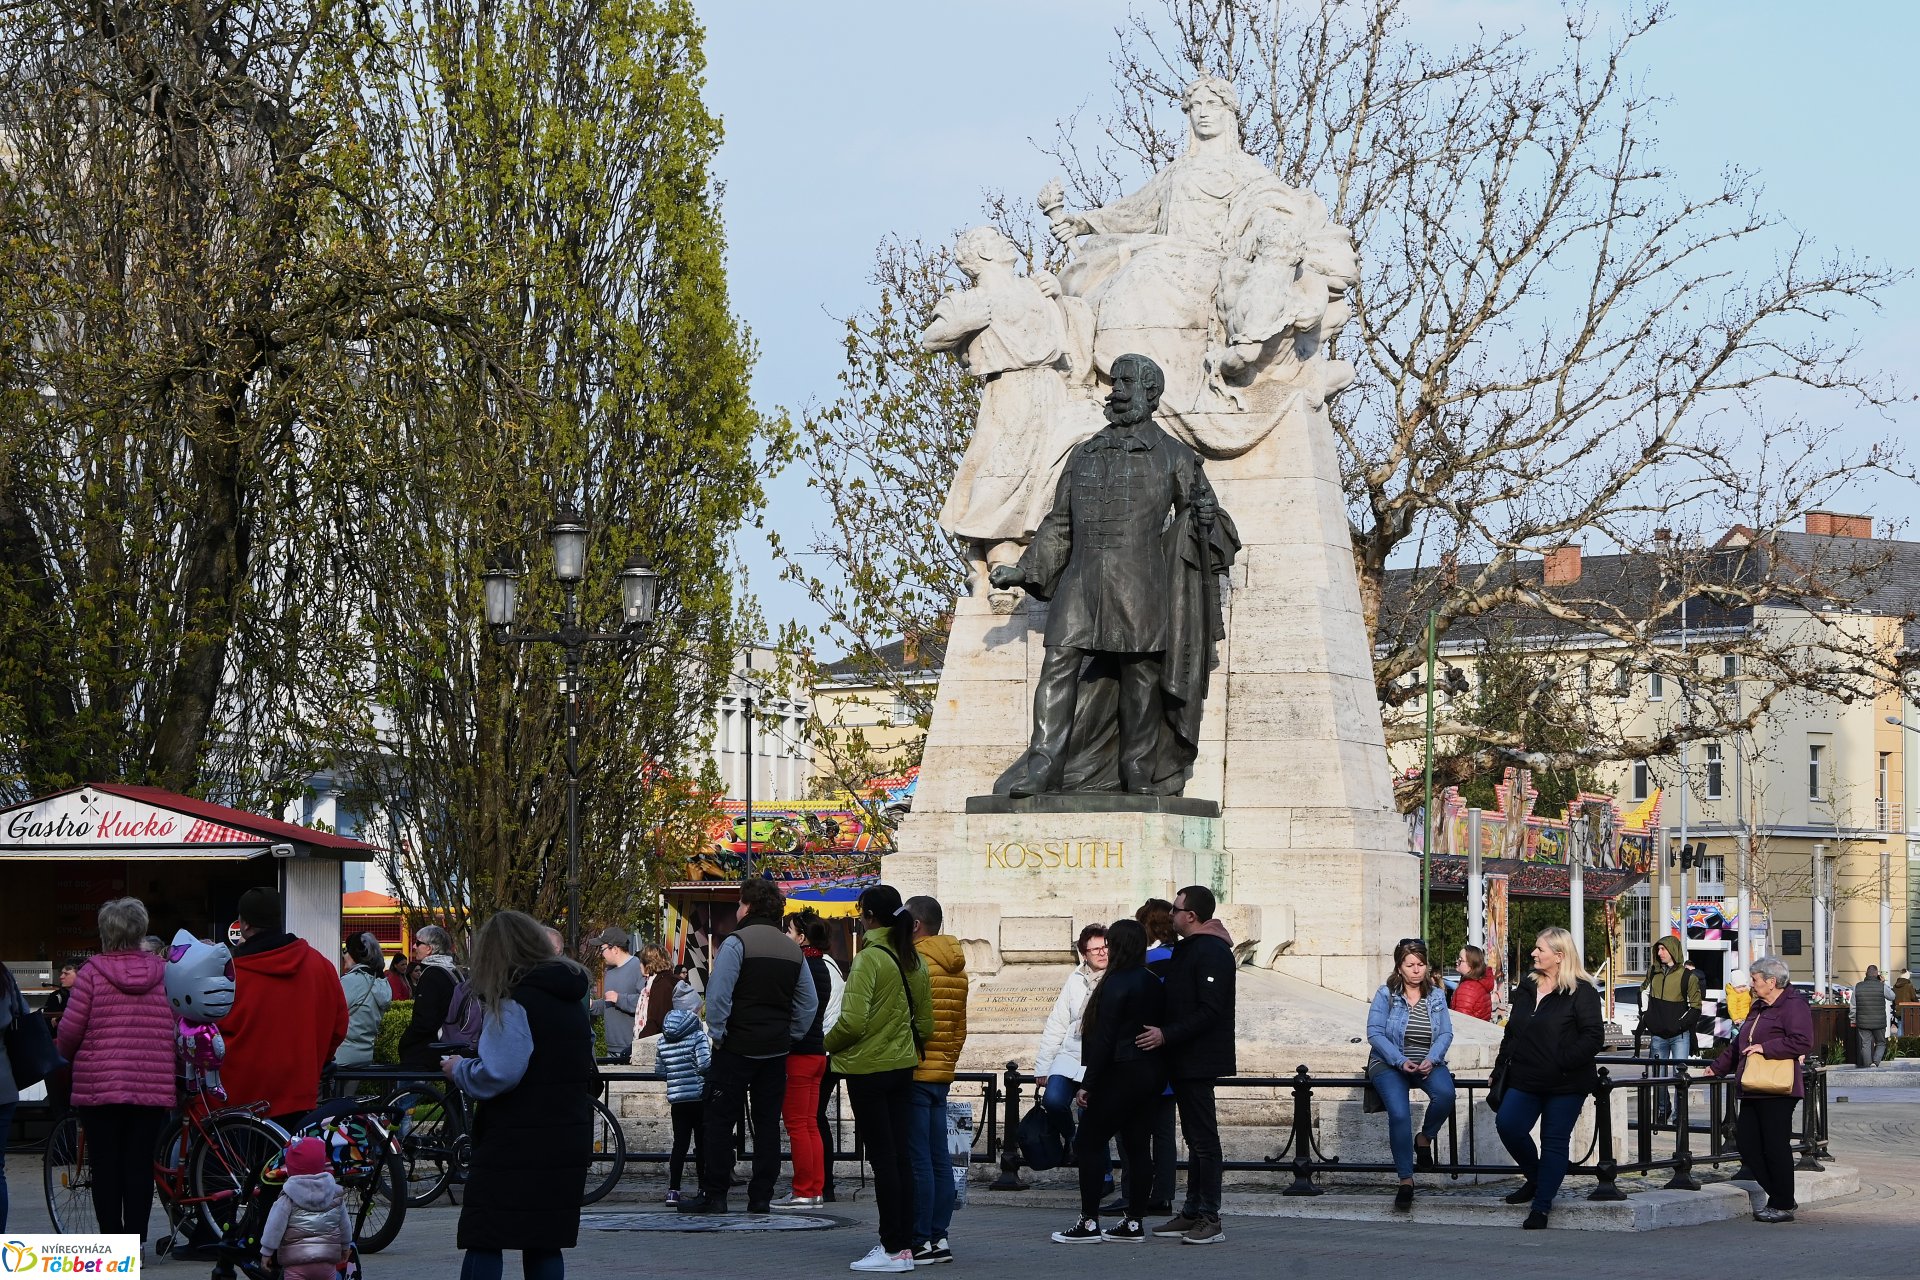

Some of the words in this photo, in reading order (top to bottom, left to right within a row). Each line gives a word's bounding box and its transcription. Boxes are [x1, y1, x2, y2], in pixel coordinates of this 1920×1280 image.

[7, 811, 94, 838] Gastro
[97, 811, 177, 838] Kuckó
[985, 841, 1124, 869] KOSSUTH
[57, 903, 102, 912] HAMBURGE
